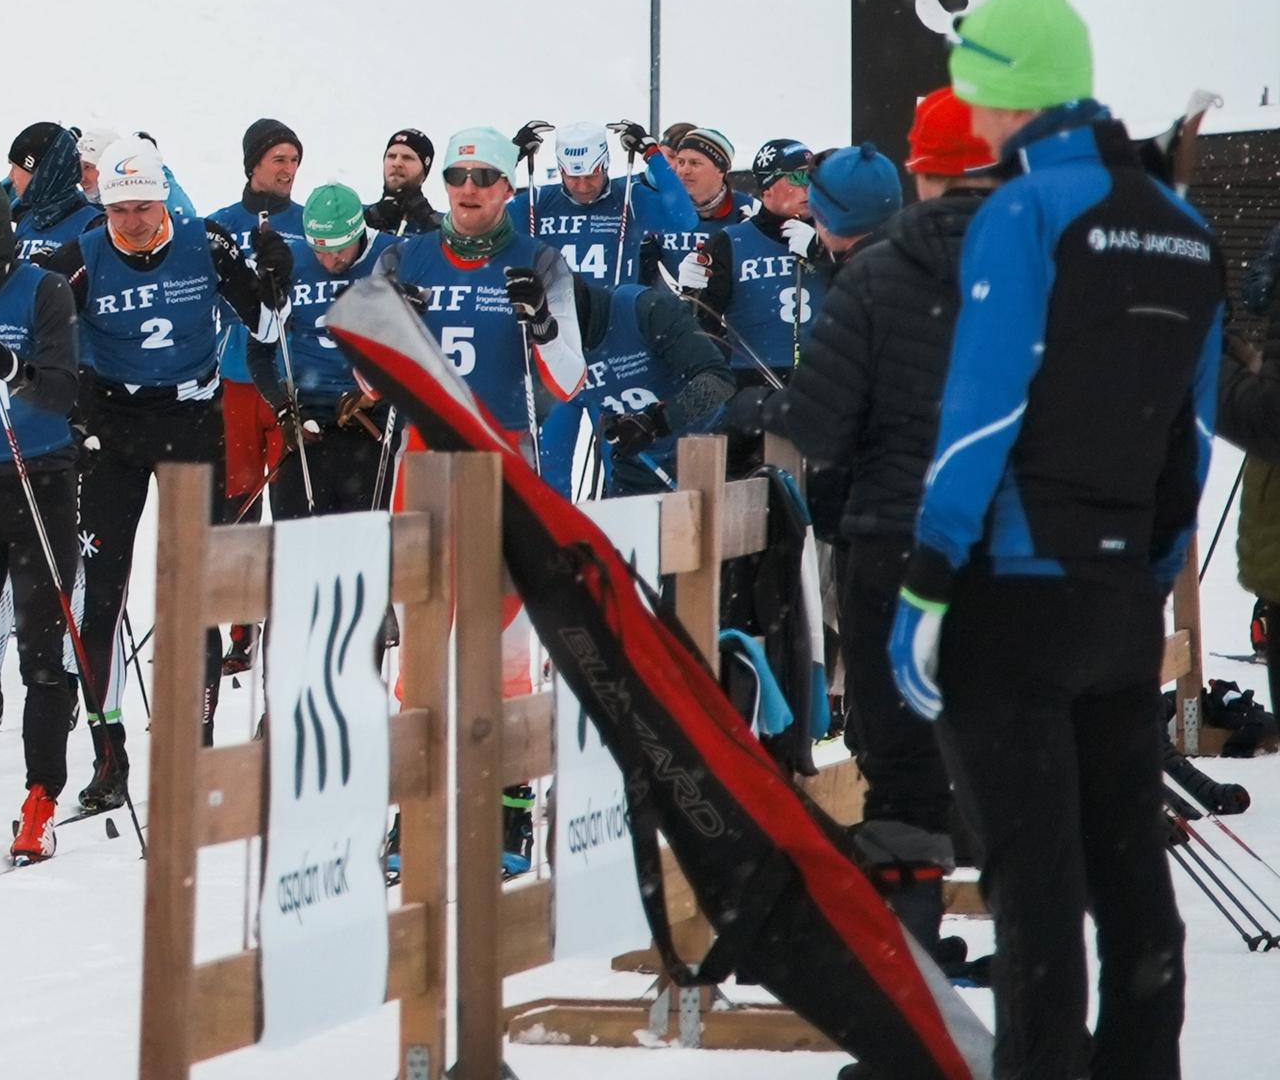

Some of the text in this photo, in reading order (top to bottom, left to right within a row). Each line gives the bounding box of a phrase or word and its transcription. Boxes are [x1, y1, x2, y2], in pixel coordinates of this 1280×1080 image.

[540, 216, 587, 234] RIF
[206, 231, 230, 250] WECO
[662, 232, 709, 251] RIF
[1108, 230, 1210, 262] AAS-JAKOBSEN
[739, 255, 797, 282] RIF
[163, 276, 209, 289] Rådgivende
[164, 284, 209, 297] Ingeniørers
[96, 284, 159, 315] RIF
[165, 293, 201, 304] Forening
[427, 286, 472, 311] IF
[475, 304, 513, 314] Forening
[779, 286, 812, 324] 8
[140, 318, 174, 349] 2
[441, 326, 476, 376] 5
[568, 804, 604, 865] asplan
[278, 837, 352, 926] asplan viak
